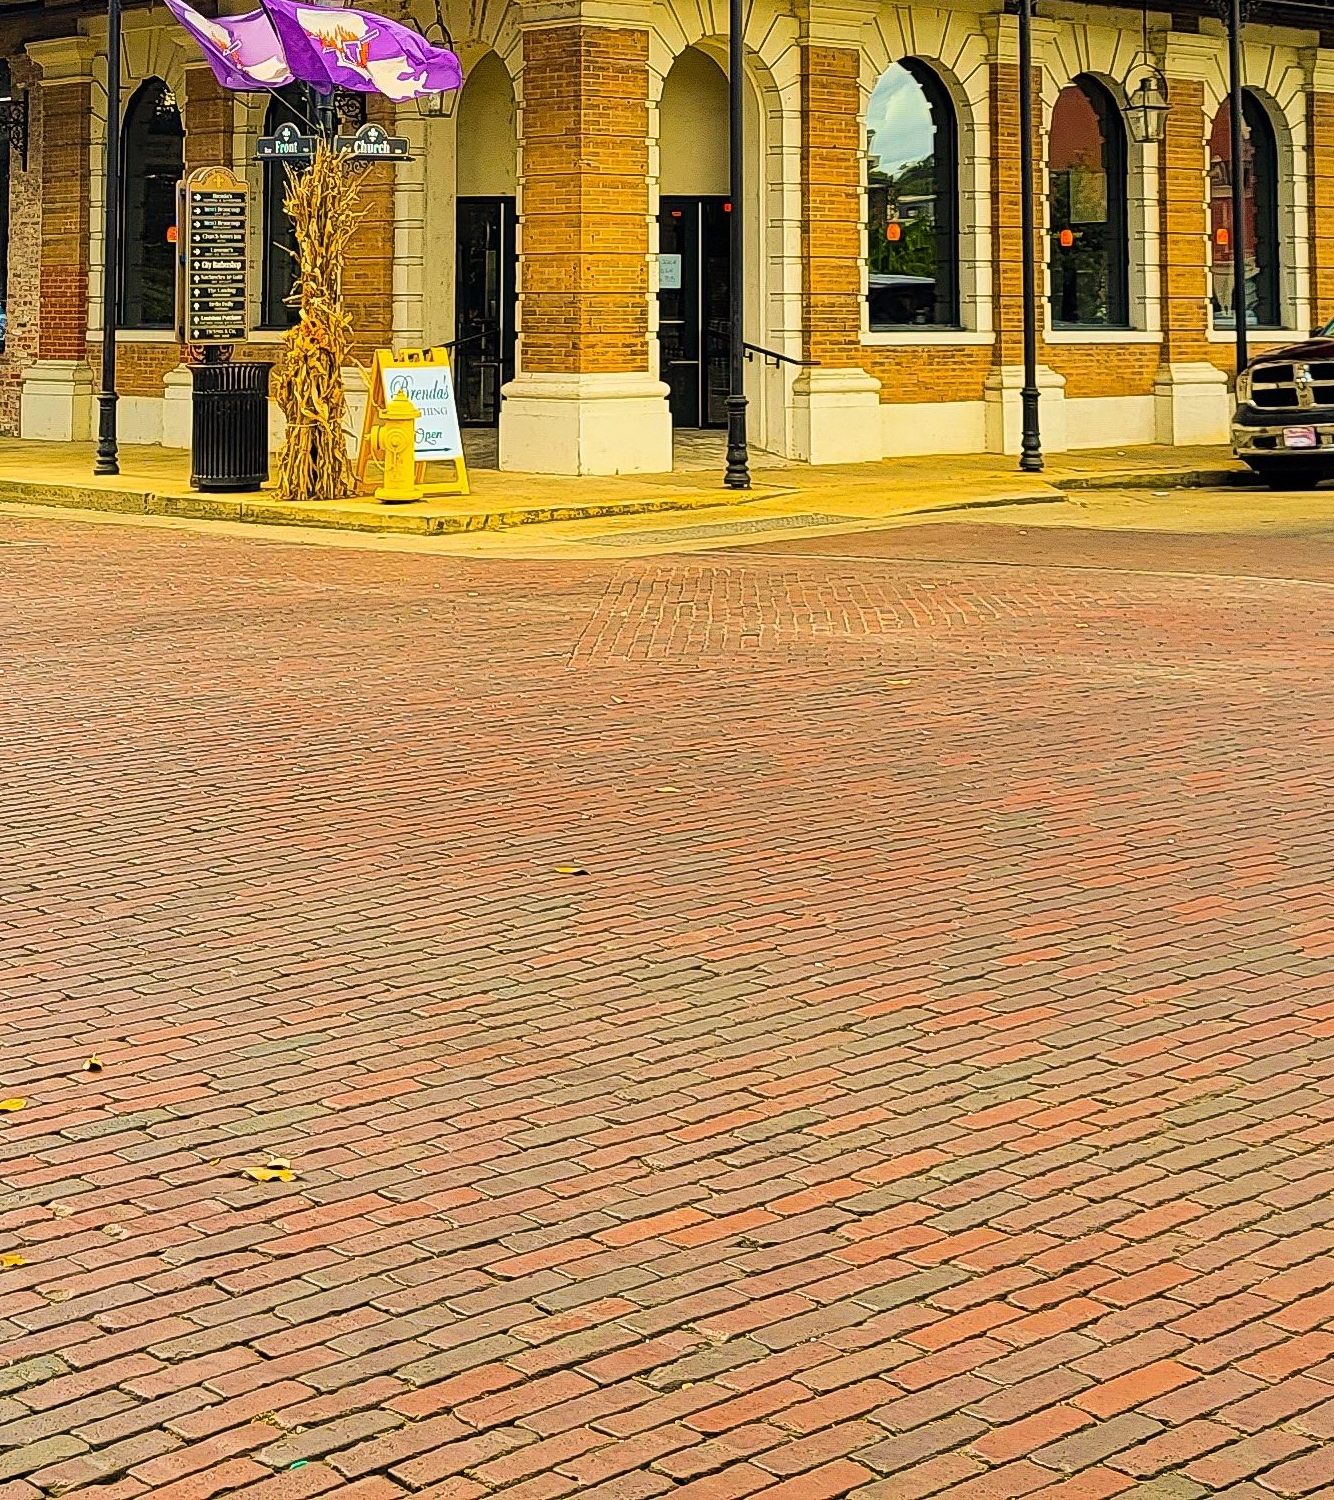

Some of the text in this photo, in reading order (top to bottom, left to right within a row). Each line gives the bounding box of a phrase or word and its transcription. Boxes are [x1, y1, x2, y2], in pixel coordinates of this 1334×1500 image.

[275, 140, 298, 154] Front
[353, 140, 391, 154] Church
[390, 374, 450, 401] Brenda's
[413, 427, 443, 446] Open
